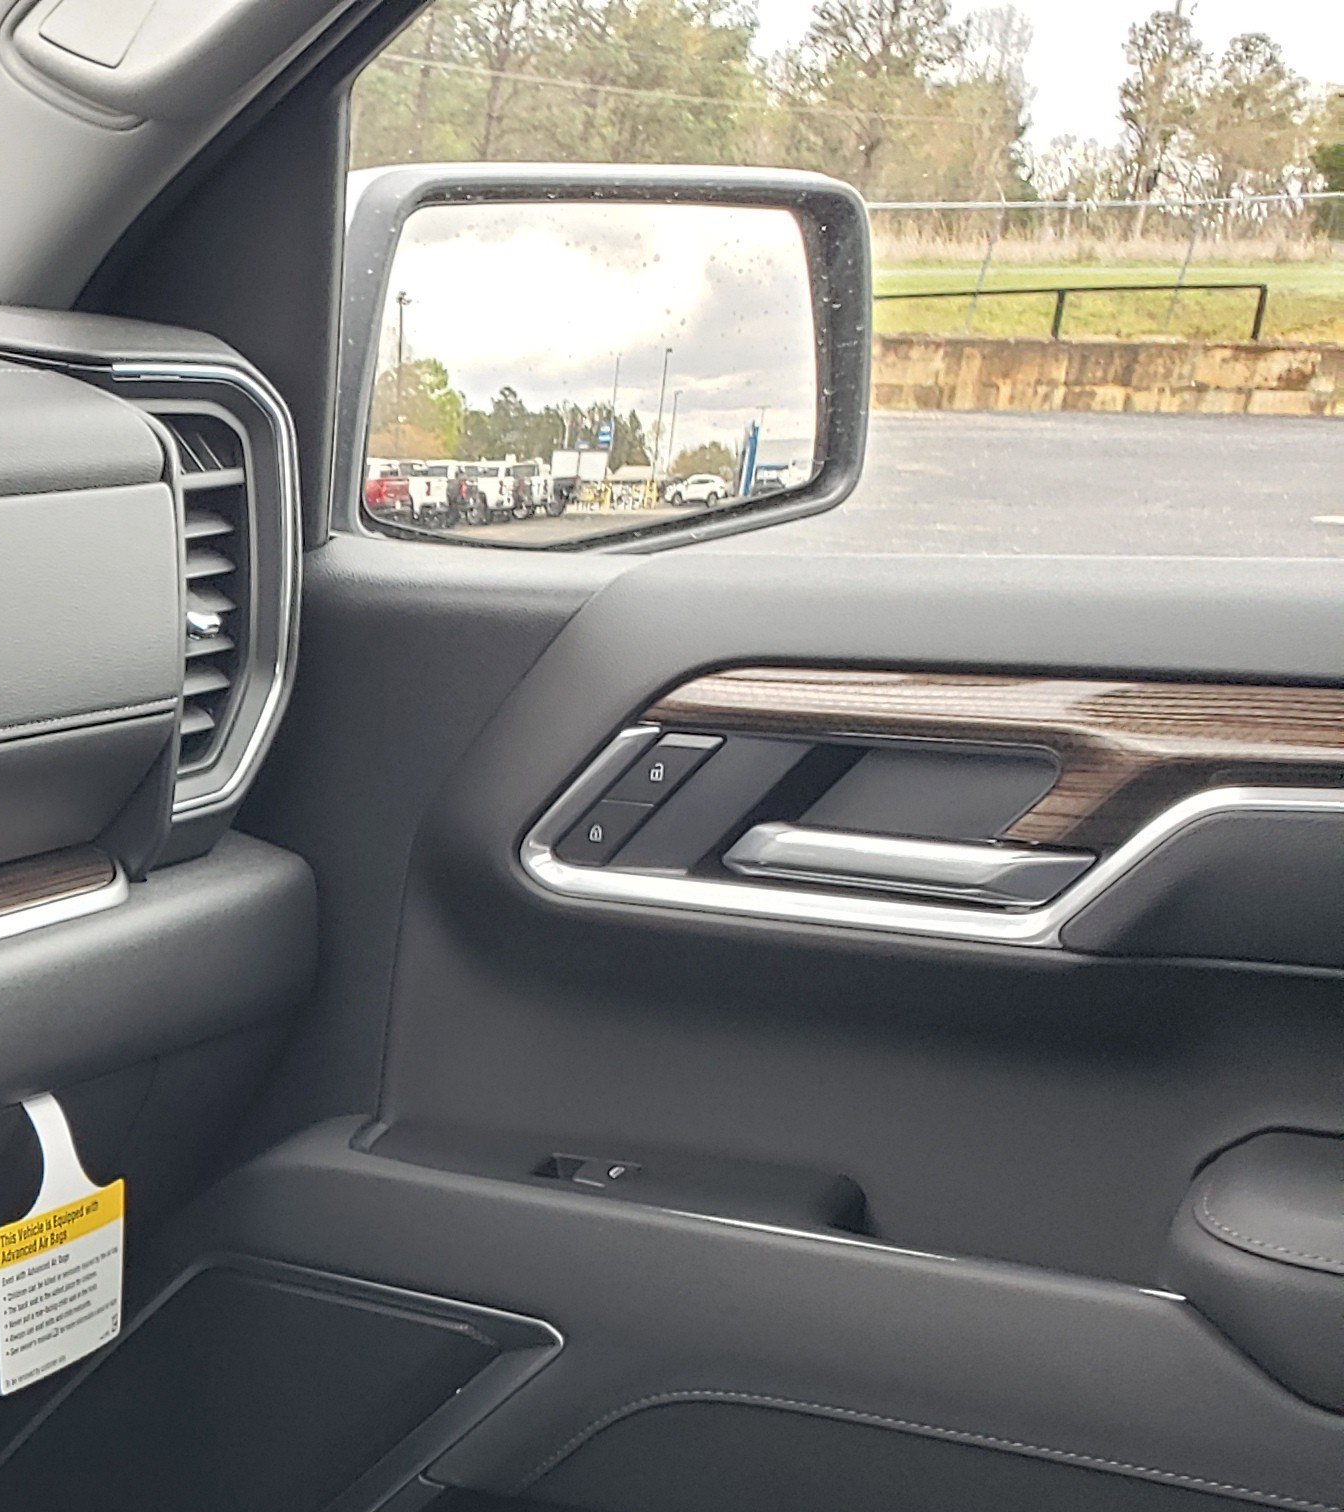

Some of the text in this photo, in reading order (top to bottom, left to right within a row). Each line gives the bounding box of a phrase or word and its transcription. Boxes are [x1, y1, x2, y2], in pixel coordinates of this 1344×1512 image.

[0, 1232, 16, 1248] This
[17, 1221, 44, 1241] Vehicle
[45, 1219, 52, 1230] is
[53, 1206, 84, 1228] Equipped
[1, 1230, 67, 1265] Advanced Air Bags
